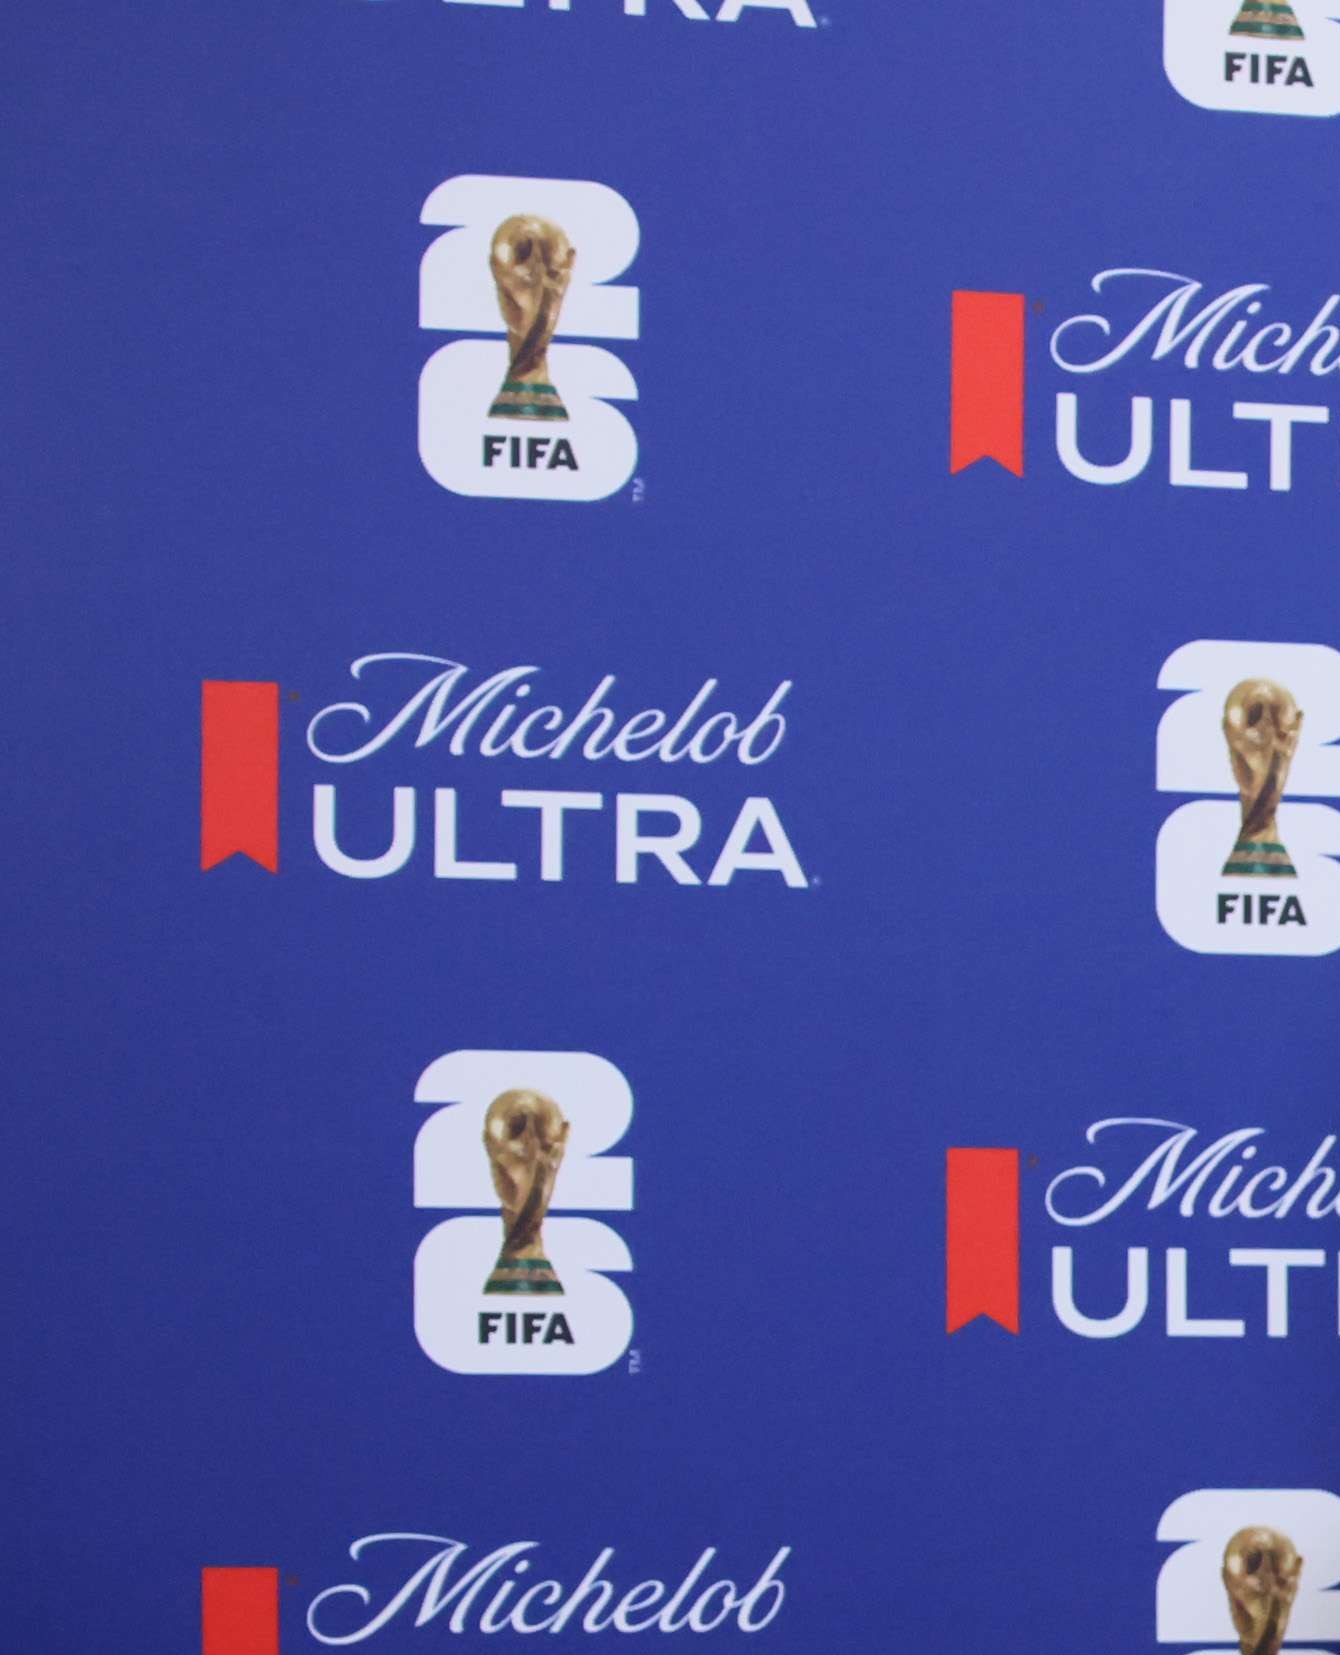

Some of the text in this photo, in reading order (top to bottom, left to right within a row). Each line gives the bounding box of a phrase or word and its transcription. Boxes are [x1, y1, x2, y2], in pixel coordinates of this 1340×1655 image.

[1225, 52, 1313, 87] FIFA
[484, 435, 578, 470] FIFA
[307, 653, 792, 765] Michelob
[314, 785, 808, 888] ULTRA
[1218, 894, 1306, 925] FIFA
[479, 1313, 574, 1344] FIFA
[307, 1533, 791, 1645] Michelob
